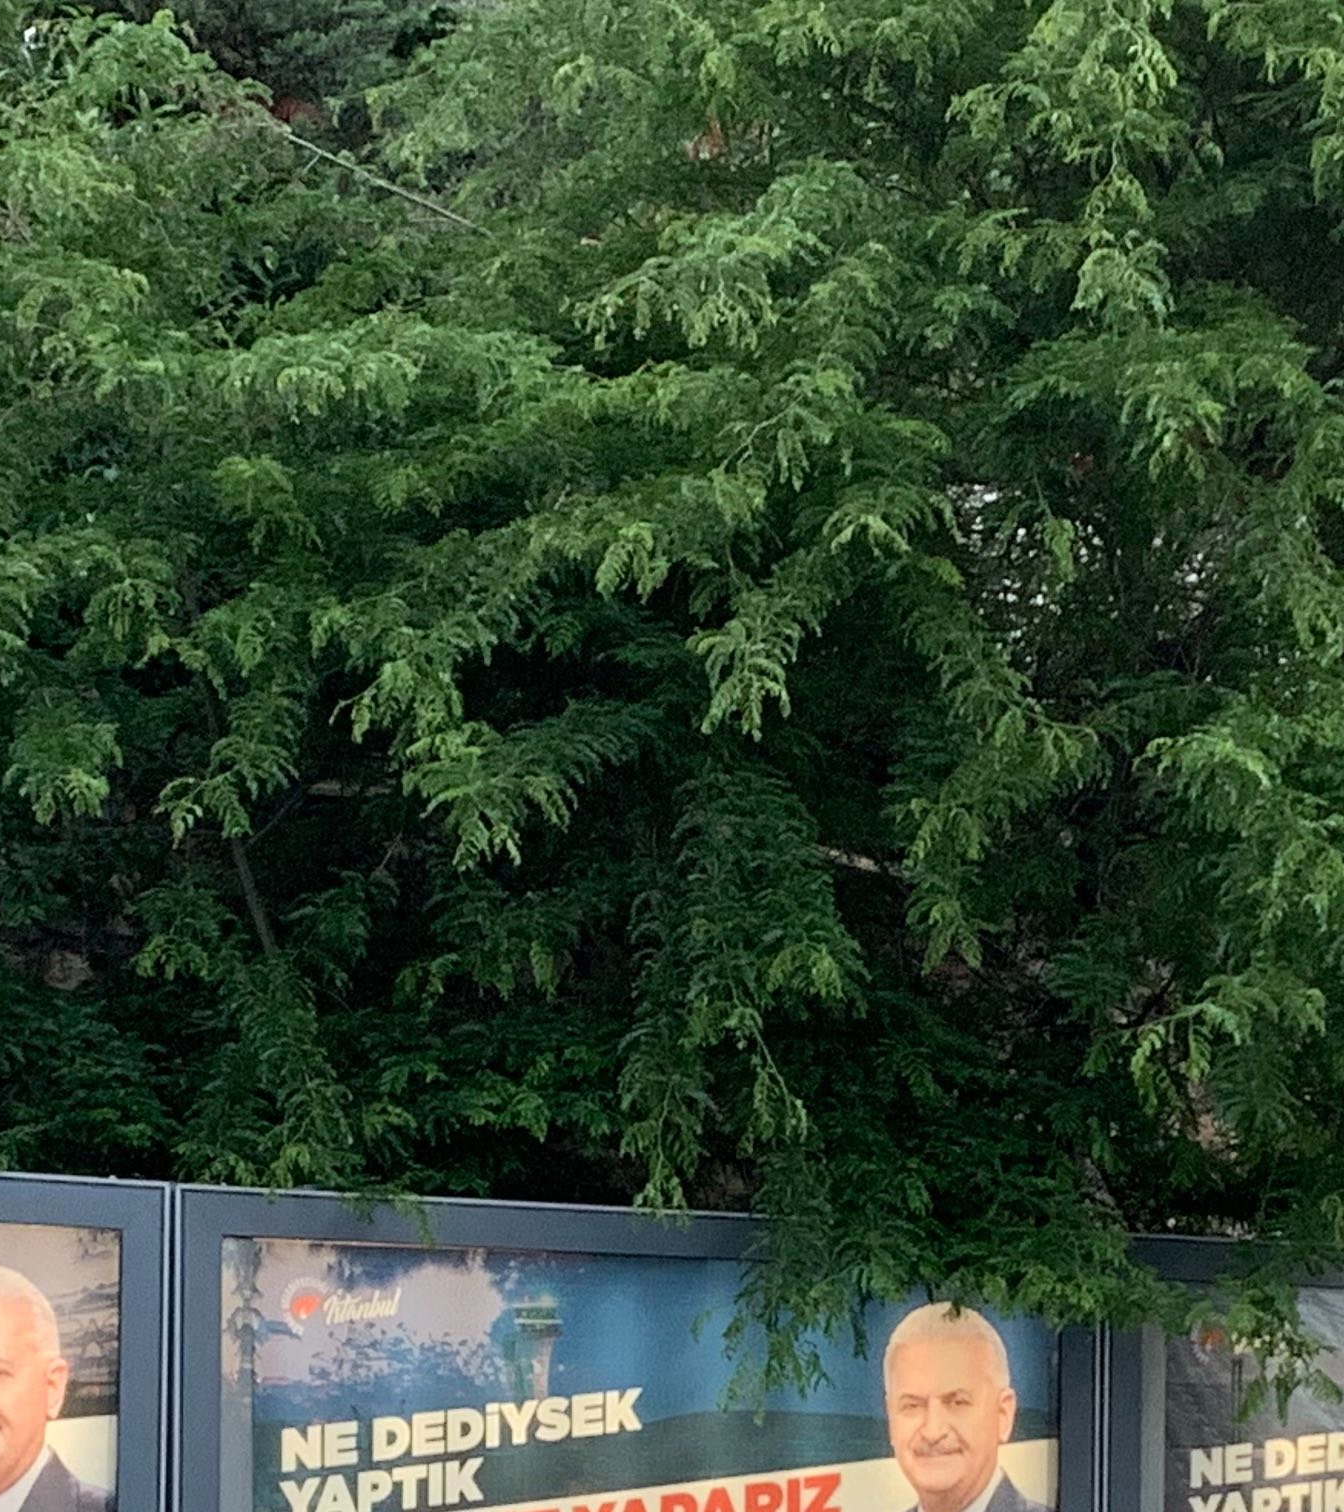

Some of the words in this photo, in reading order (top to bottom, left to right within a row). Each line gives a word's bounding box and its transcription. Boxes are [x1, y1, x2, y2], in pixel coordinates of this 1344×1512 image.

[323, 1287, 402, 1326] İstanbul
[280, 1420, 359, 1473] NE
[371, 1387, 643, 1463] DEDİYSEK
[1189, 1442, 1254, 1489] NE
